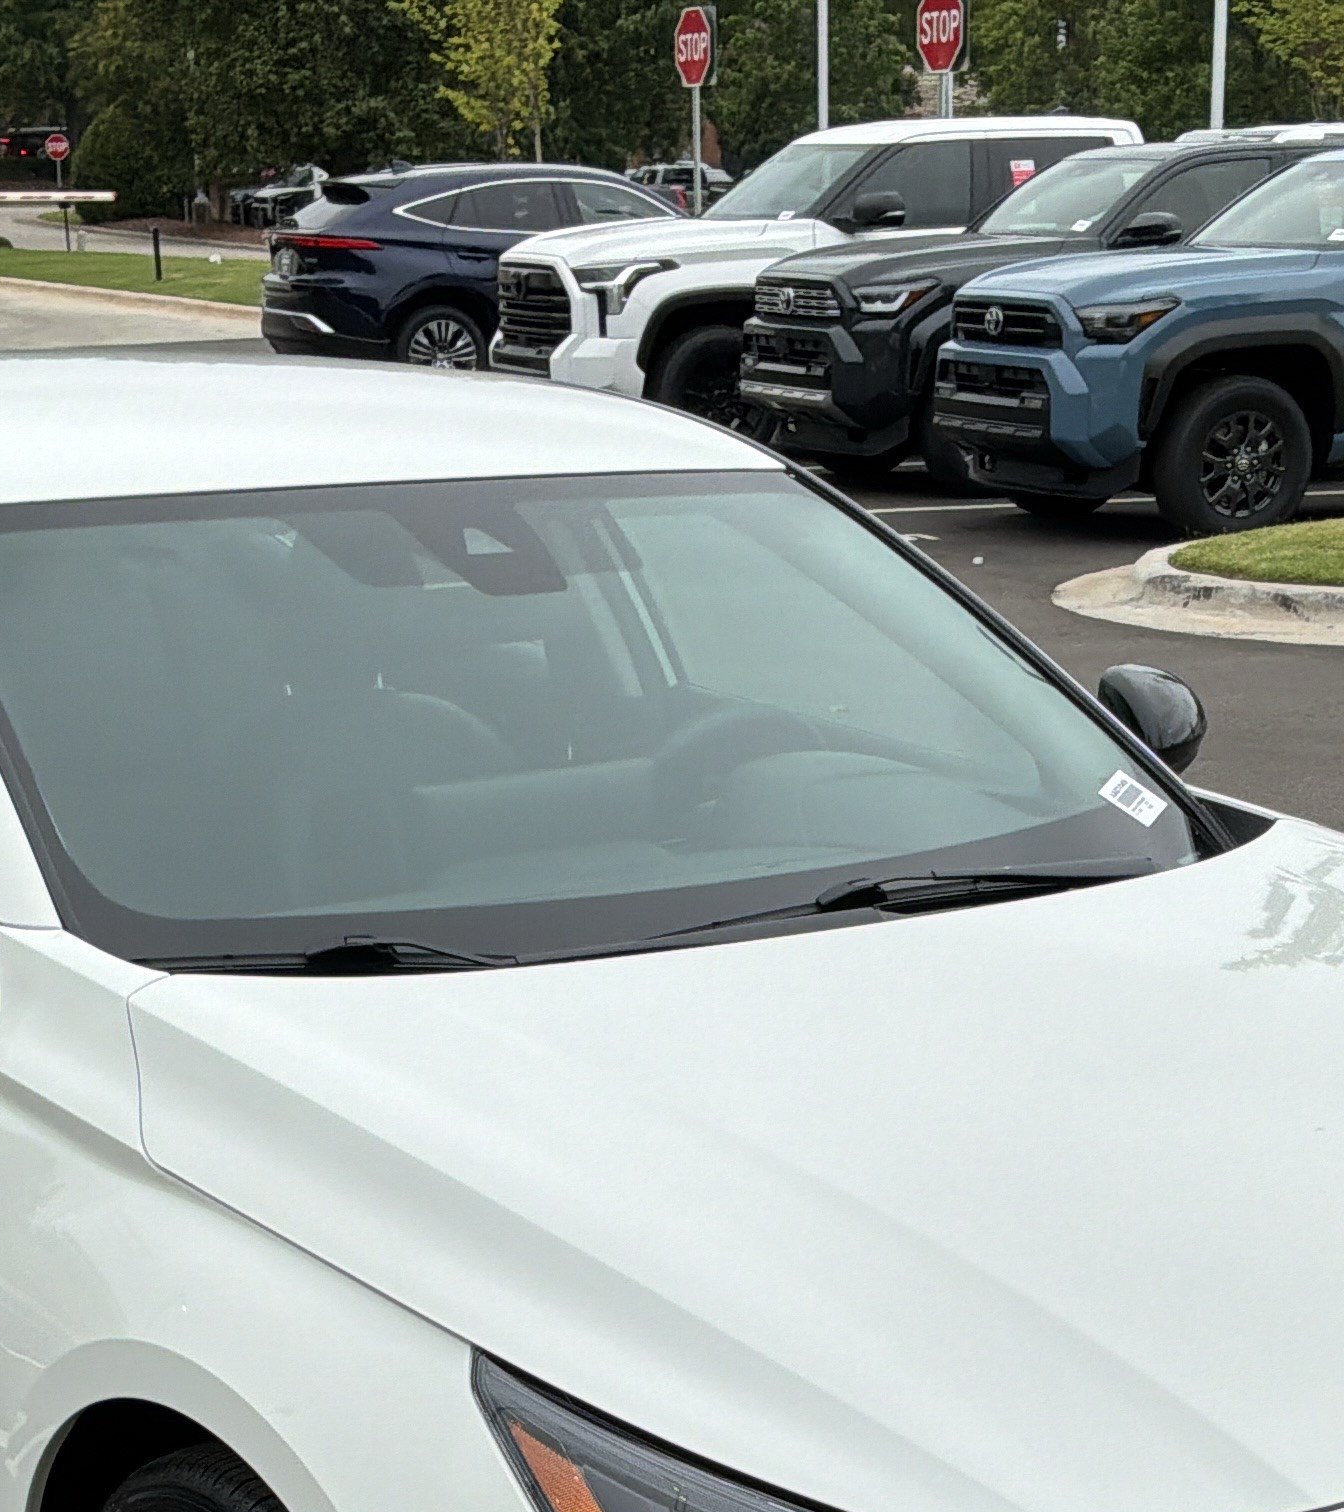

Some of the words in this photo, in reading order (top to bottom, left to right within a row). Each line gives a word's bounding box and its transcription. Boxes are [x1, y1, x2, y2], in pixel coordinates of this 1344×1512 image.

[921, 9, 959, 45] STOP
[678, 32, 707, 63] STOP
[47, 141, 68, 152] STOP
